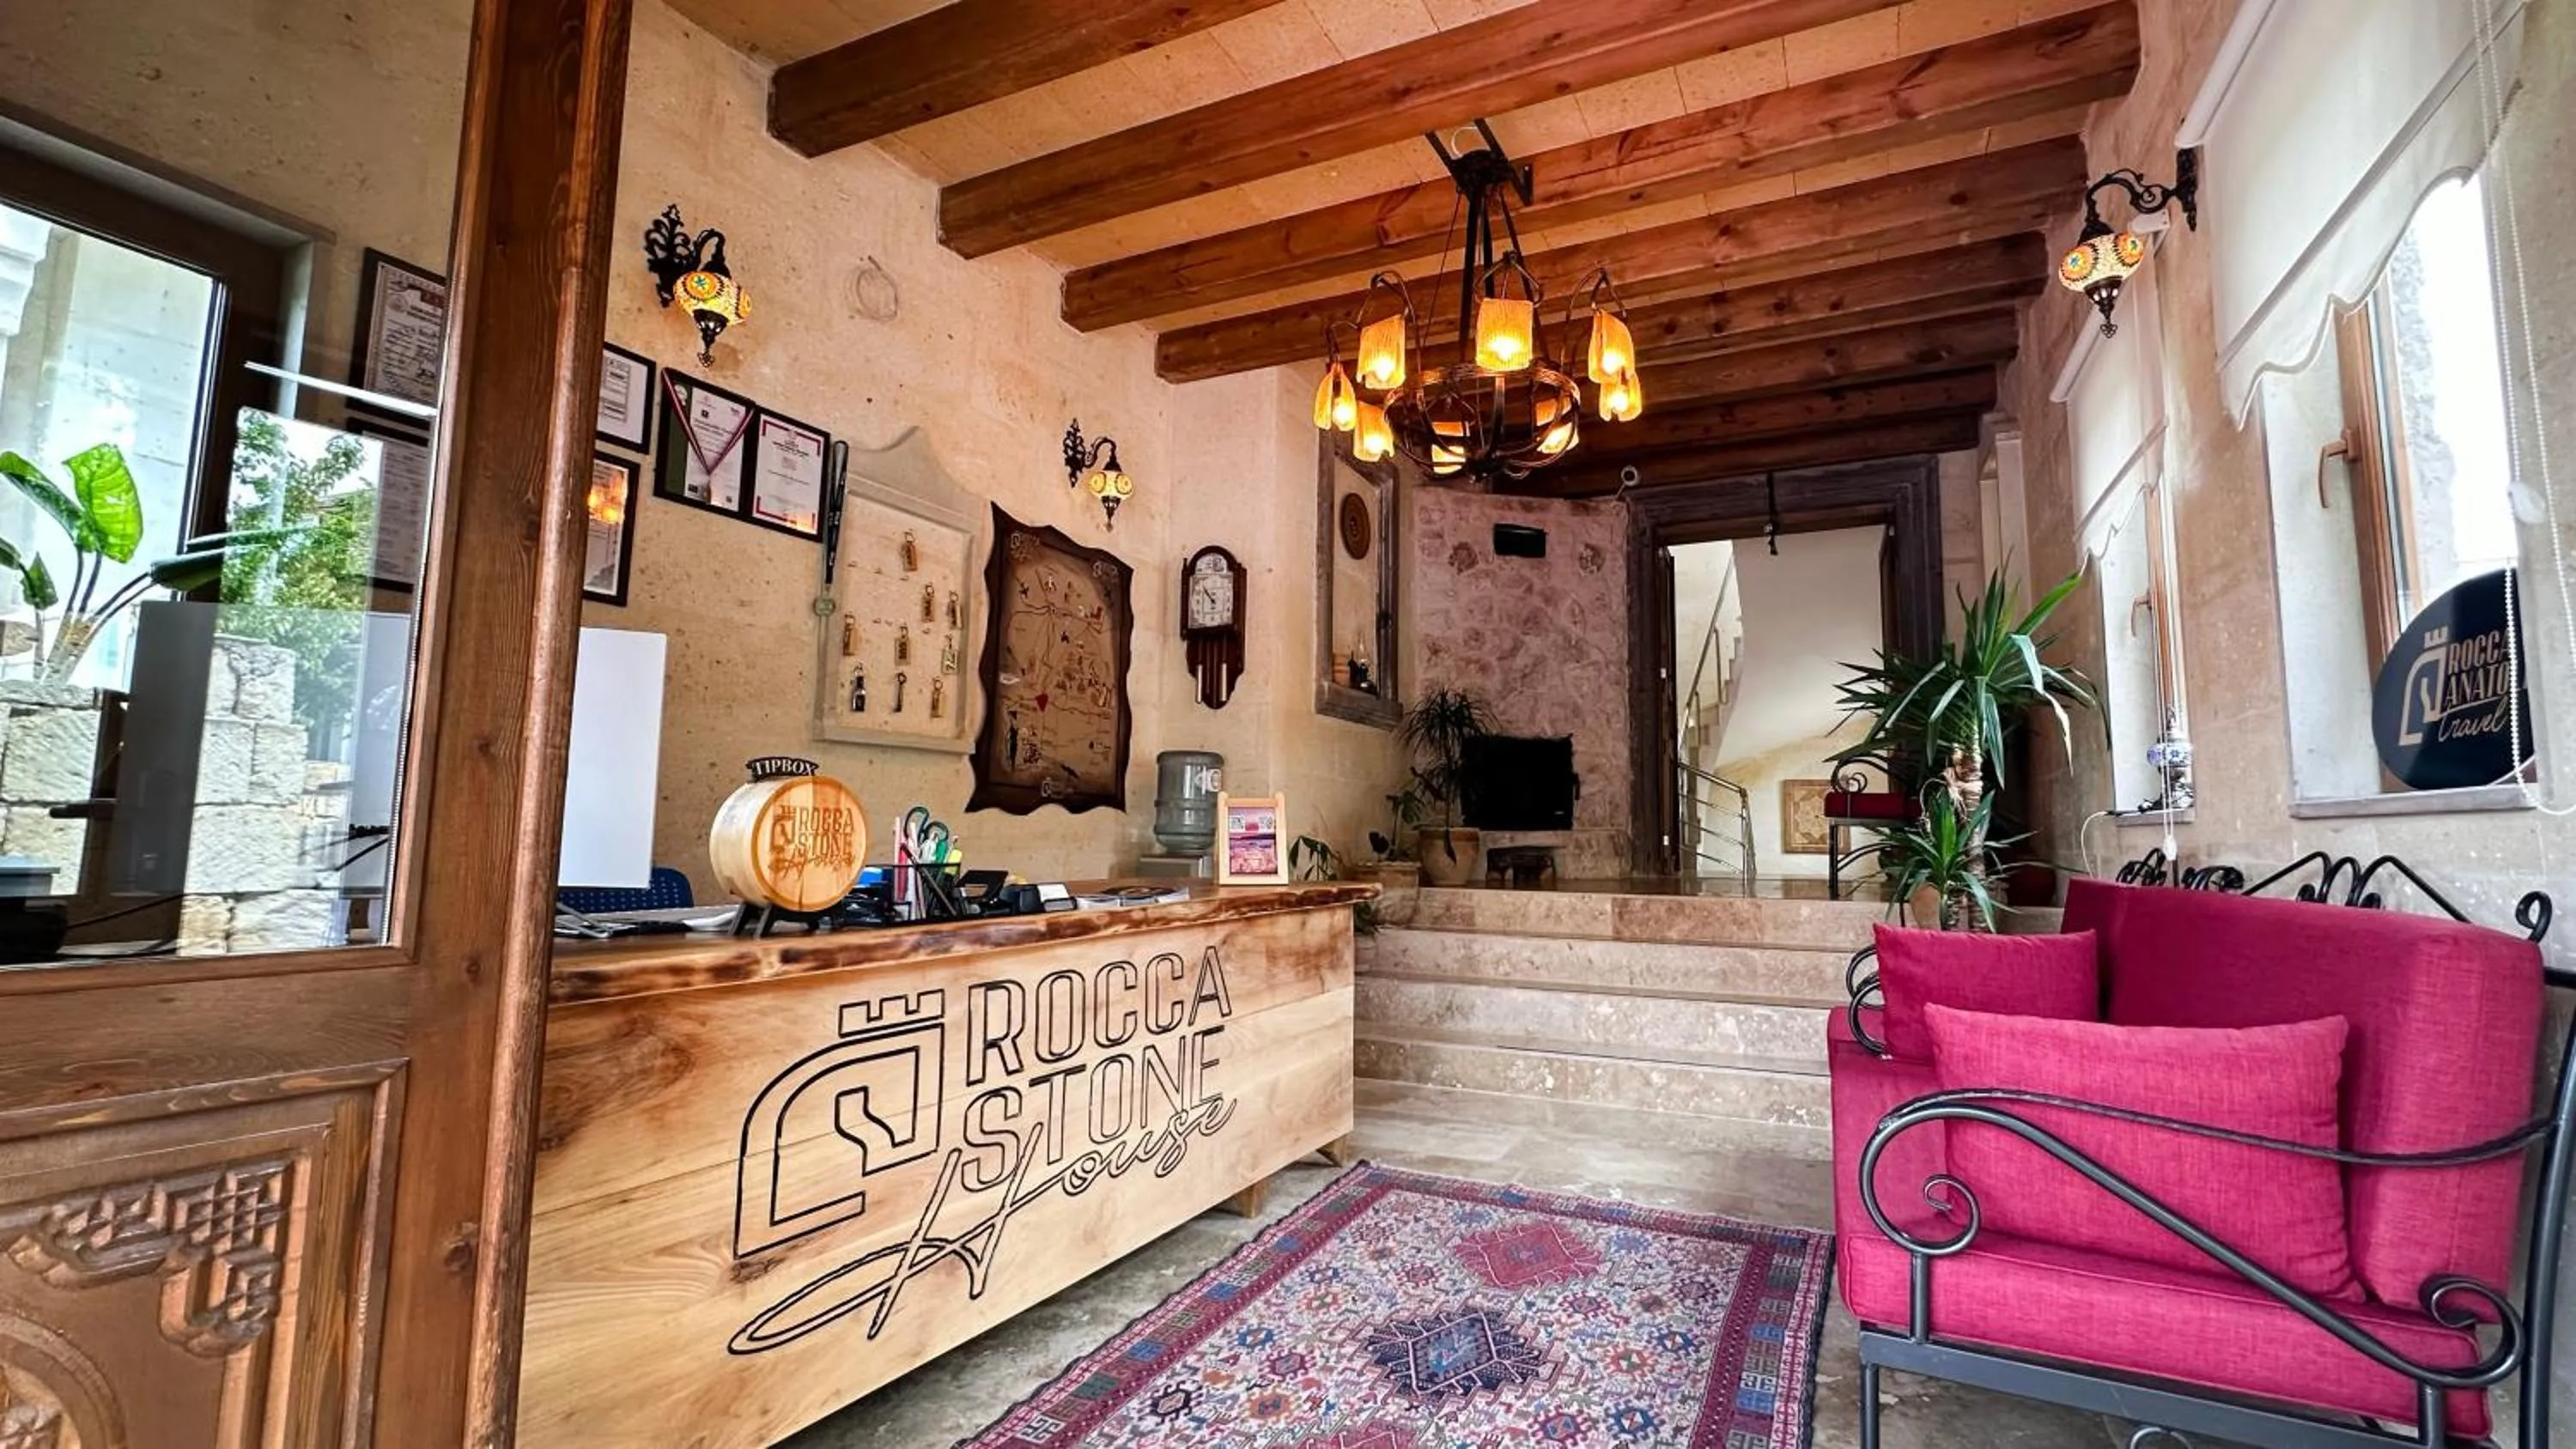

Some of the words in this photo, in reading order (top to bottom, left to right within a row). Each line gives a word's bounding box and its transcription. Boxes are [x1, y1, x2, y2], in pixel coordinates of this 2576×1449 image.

[752, 759, 817, 775] TIPBOX
[798, 831, 854, 857] STONE
[799, 806, 854, 832] ROCCA
[966, 945, 1232, 1087] ROCCA
[961, 1024, 1225, 1192] STONE
[728, 1097, 1237, 1355] House
